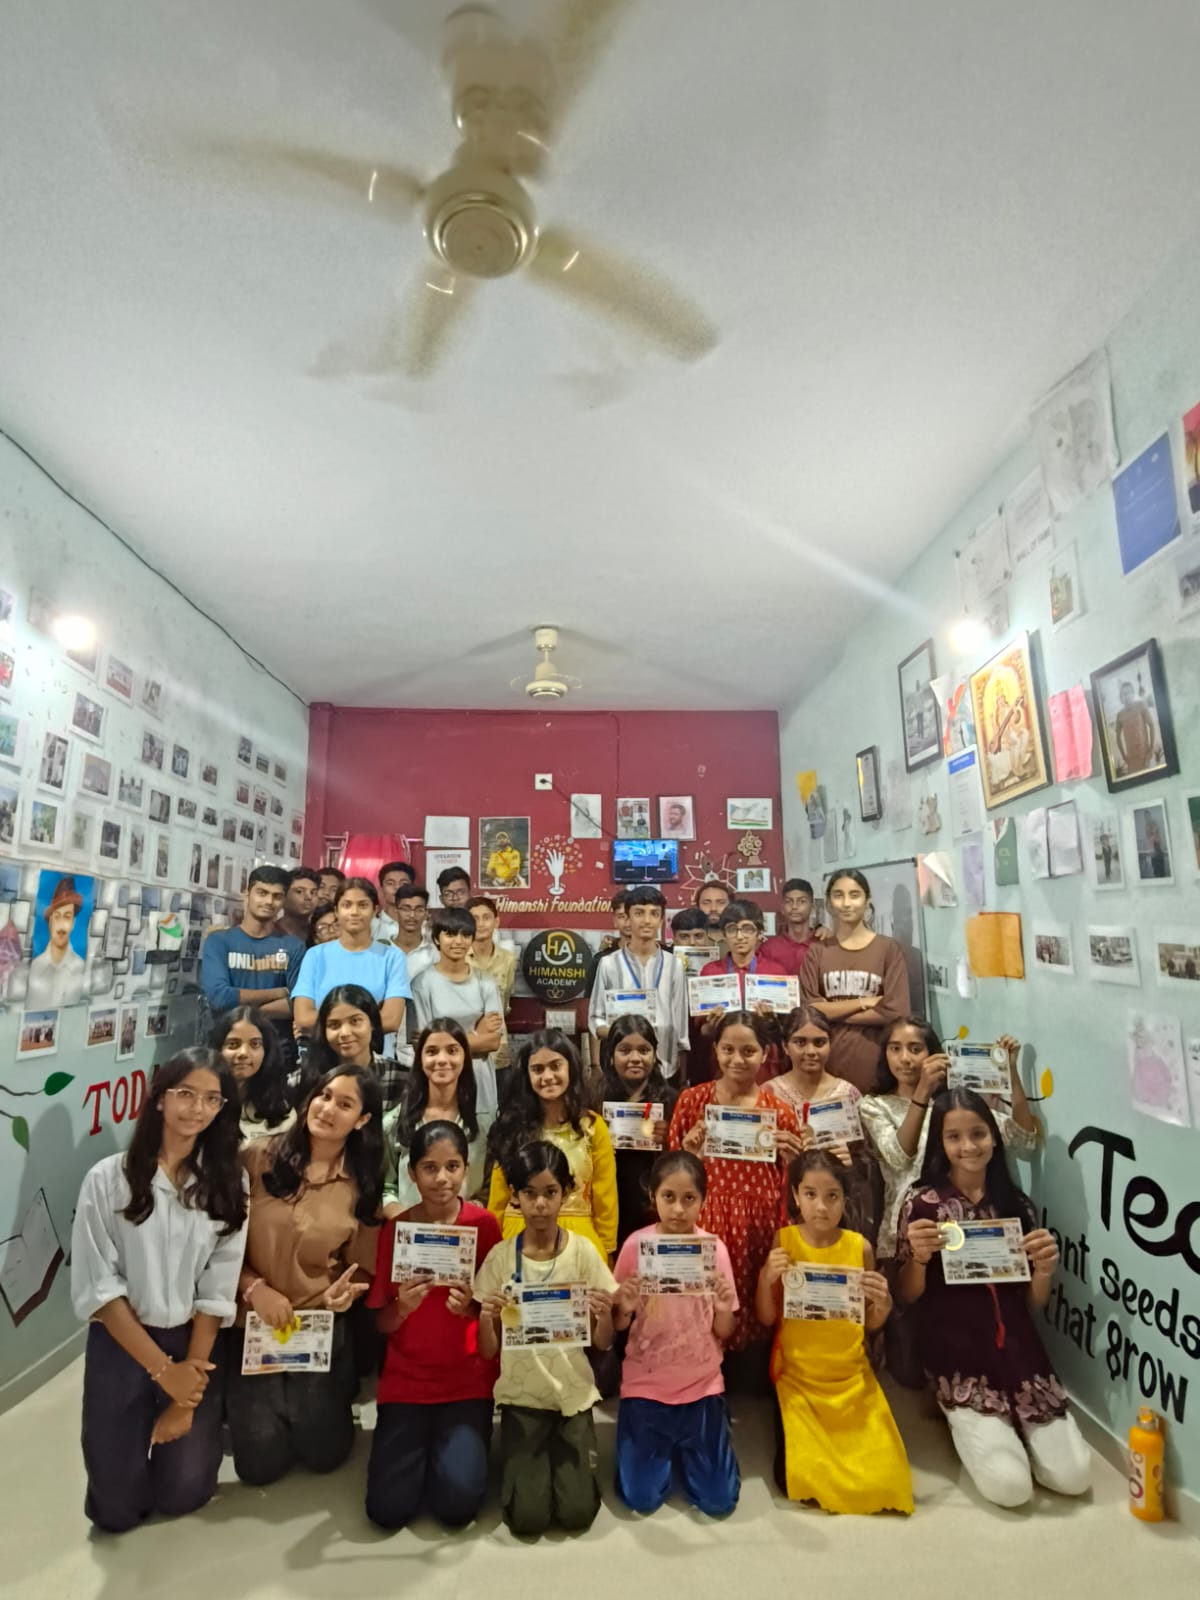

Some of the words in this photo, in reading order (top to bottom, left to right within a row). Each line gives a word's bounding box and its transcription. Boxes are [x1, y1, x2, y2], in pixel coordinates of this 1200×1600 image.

[495, 896, 549, 913] Himanshi
[528, 966, 587, 979] HIMANSHI
[536, 977, 578, 987] ACADEMY
[82, 1064, 160, 1137] TOD
[1100, 1257, 1200, 1360] seeds
[1105, 1319, 1189, 1425] grow
